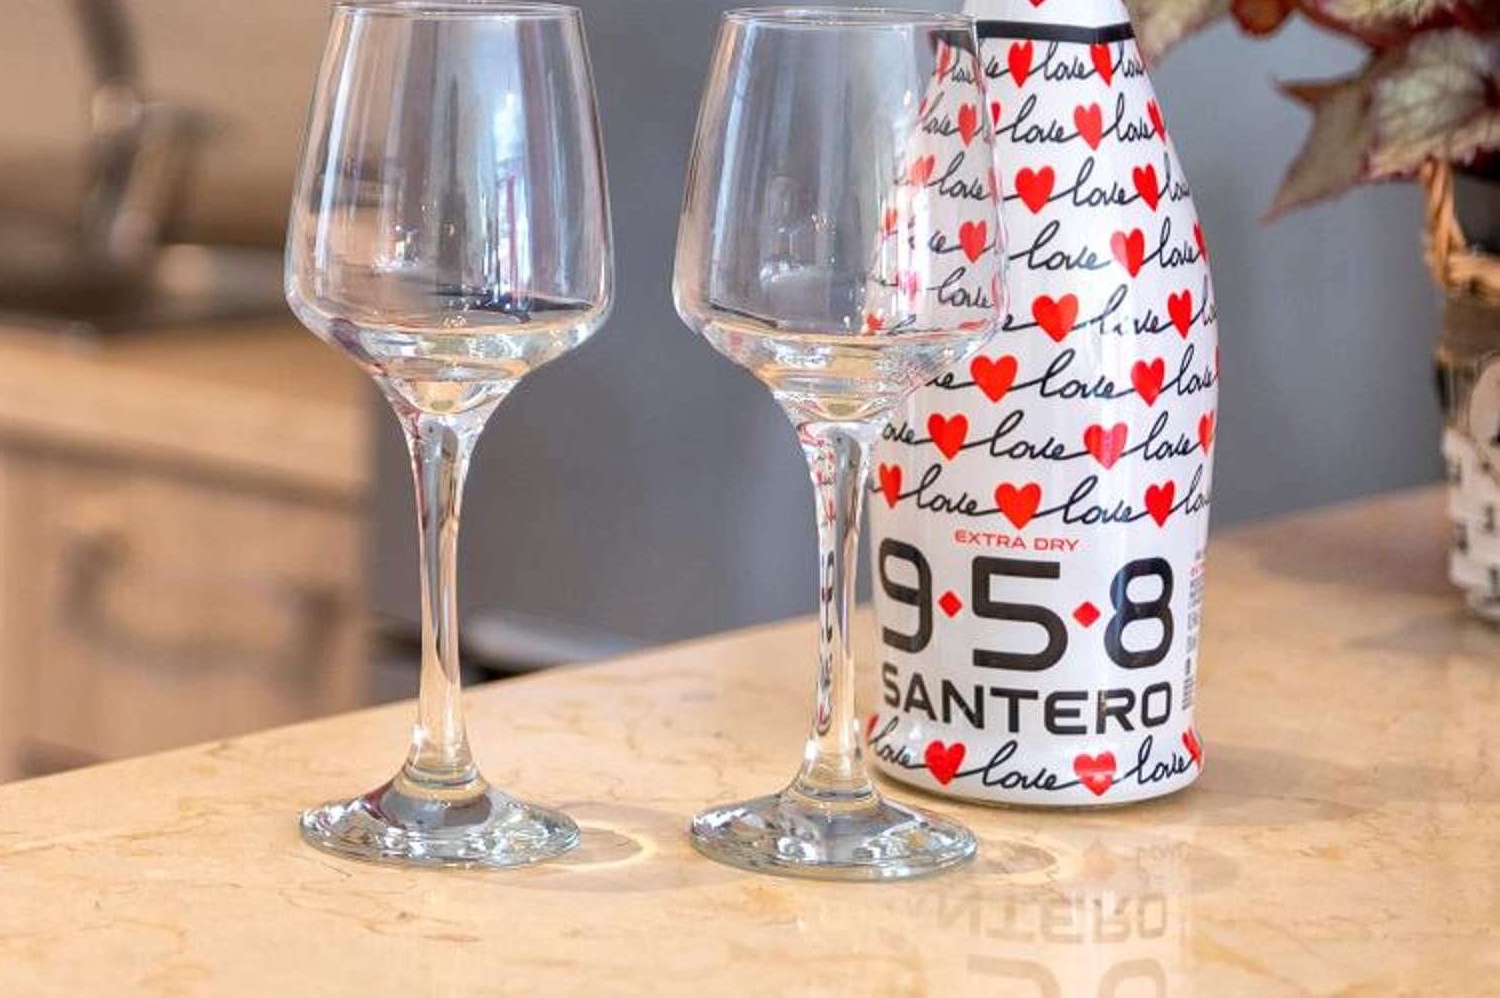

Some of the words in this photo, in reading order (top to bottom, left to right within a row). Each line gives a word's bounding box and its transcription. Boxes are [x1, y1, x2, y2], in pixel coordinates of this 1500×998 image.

[1038, 41, 1091, 82] love
[1006, 93, 1069, 143] love
[1106, 92, 1154, 142] love
[934, 151, 988, 201] love
[1067, 155, 1131, 207] love
[1020, 220, 1103, 271] love
[1152, 215, 1198, 268] love
[1033, 348, 1121, 399] love
[882, 421, 917, 445] ove
[982, 409, 1071, 460] love
[1138, 410, 1194, 460] love
[909, 462, 983, 517] love
[1056, 474, 1135, 525] love
[954, 529, 1026, 550] EXTRA
[1033, 534, 1081, 552] DRY
[882, 661, 1173, 736] SANTERO
[871, 715, 913, 769] love
[975, 739, 1059, 790] love
[1132, 734, 1191, 784] love
